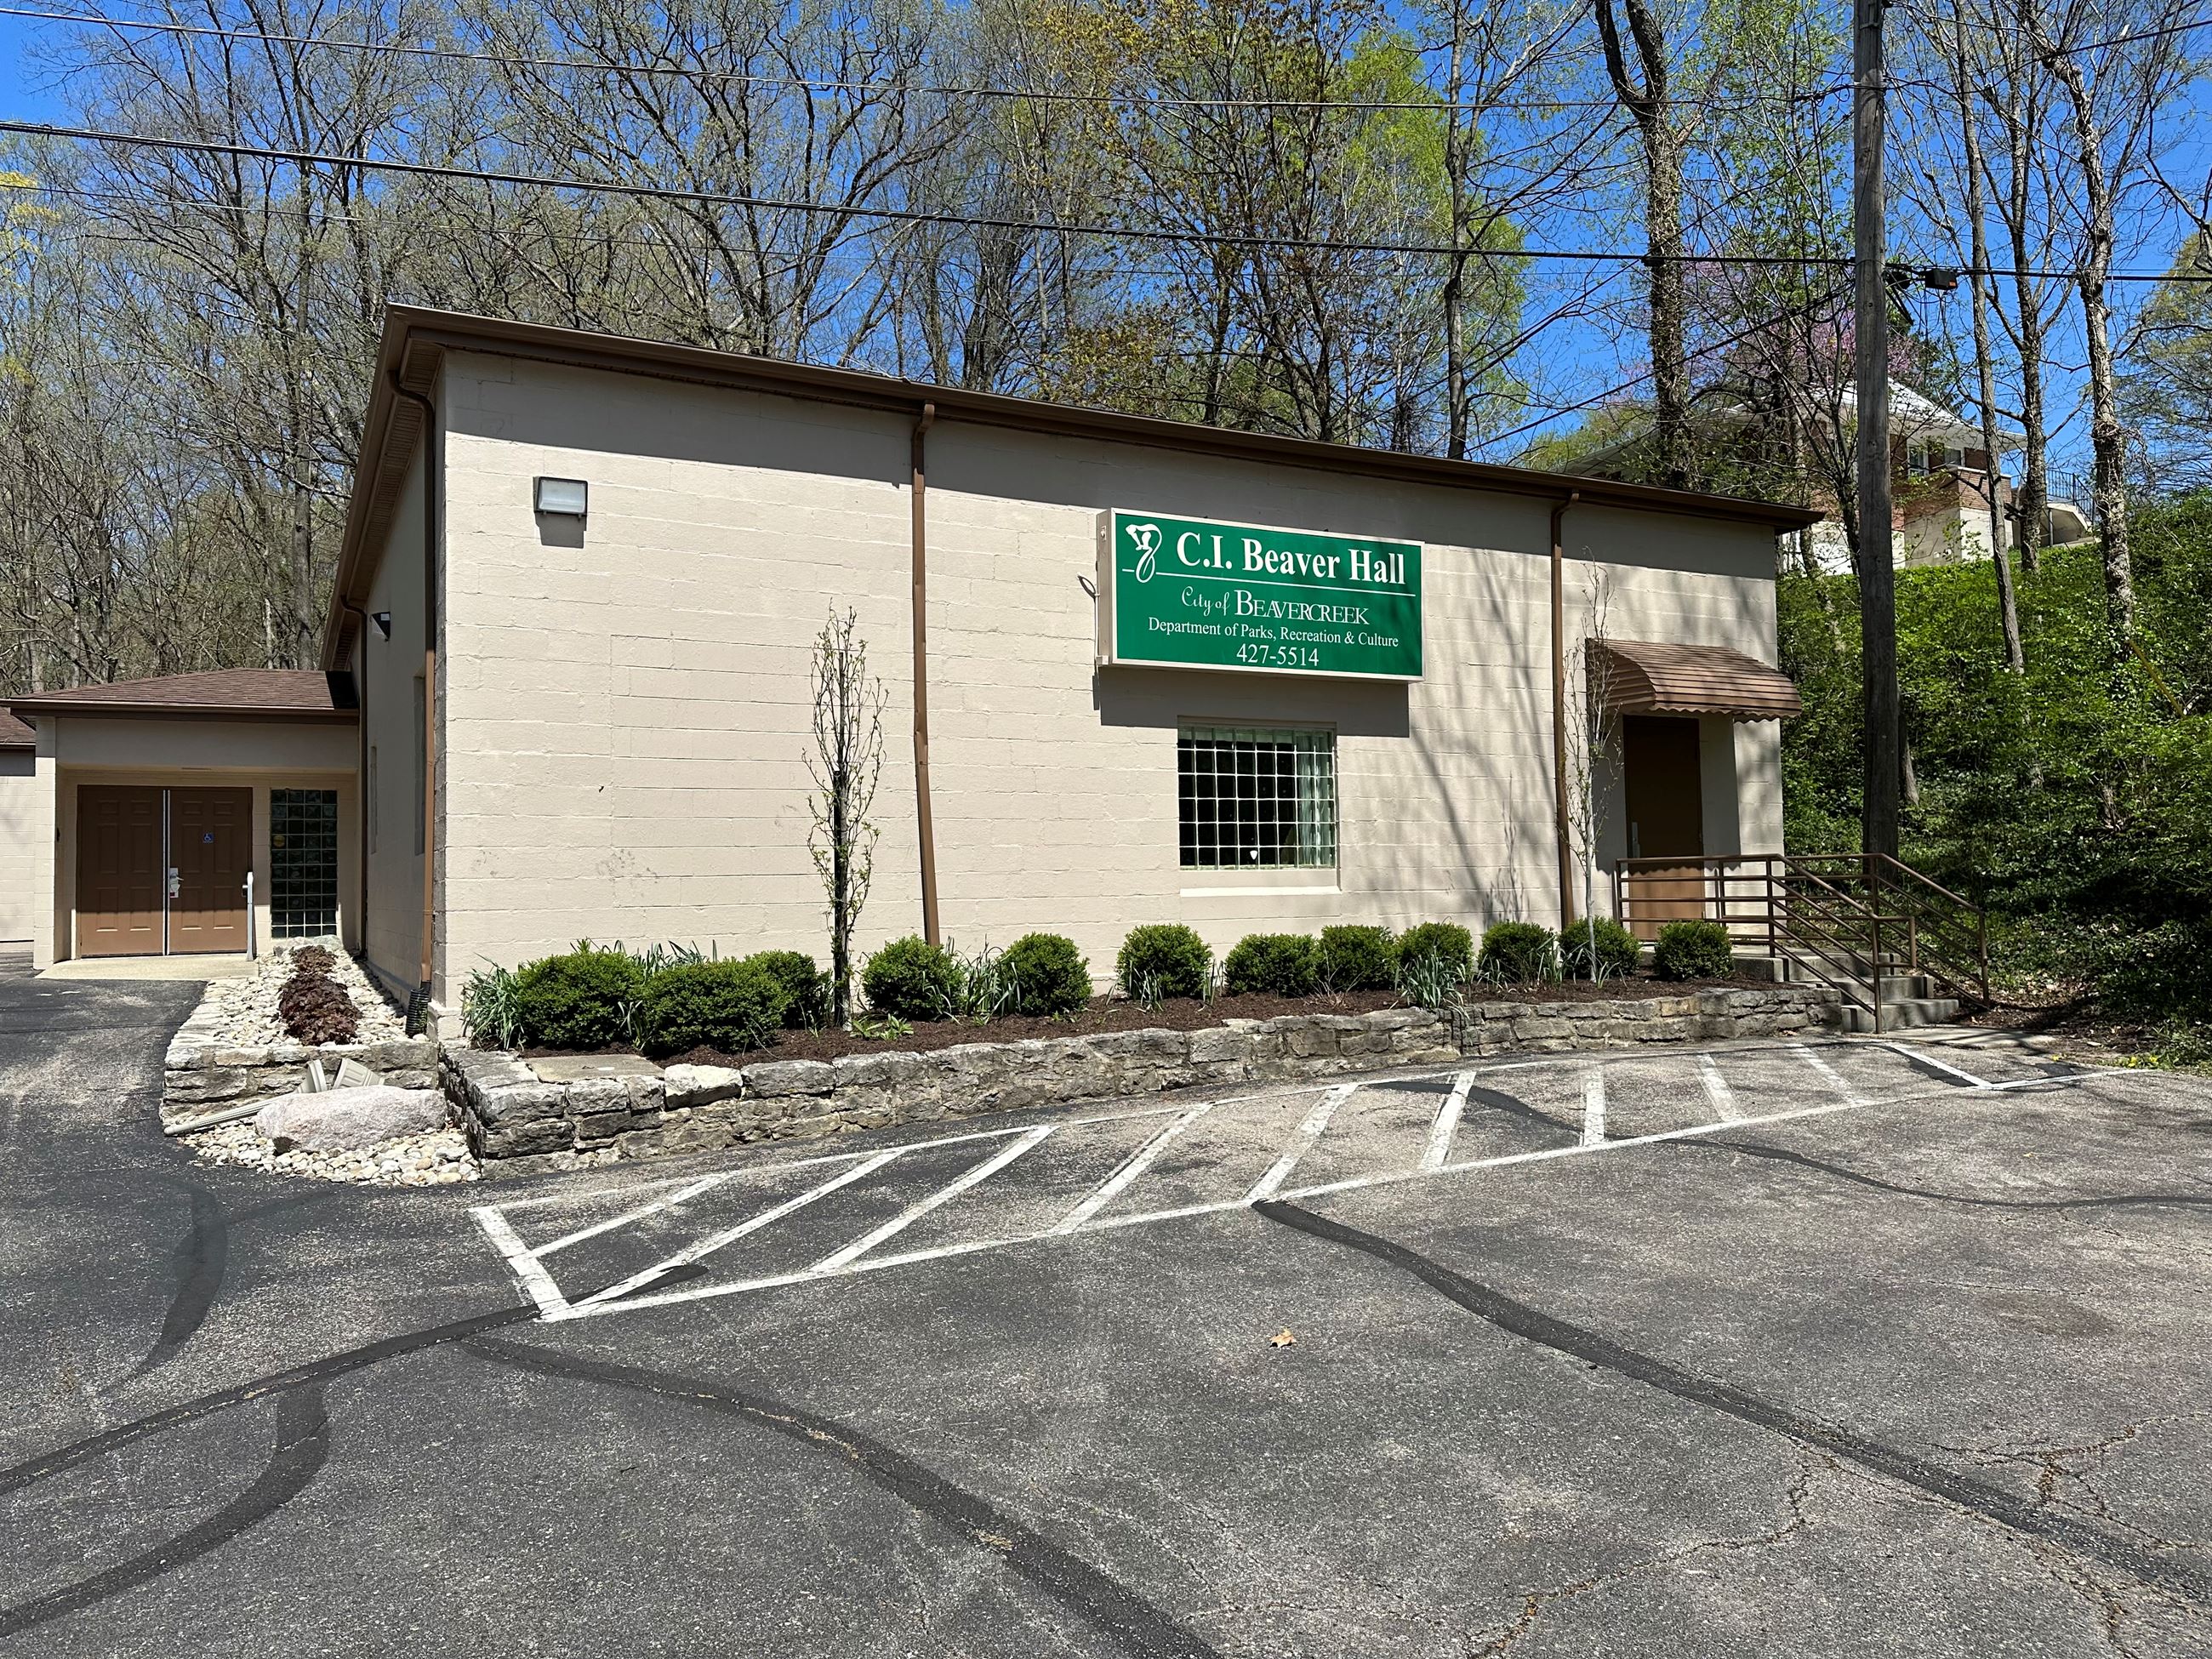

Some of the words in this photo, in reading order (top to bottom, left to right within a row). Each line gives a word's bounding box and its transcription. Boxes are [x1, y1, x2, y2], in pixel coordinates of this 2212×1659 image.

[1177, 533, 1232, 570] C.I.
[1241, 539, 1340, 579] Beaver
[1348, 549, 1406, 584] Hall
[1182, 586, 1211, 616] City
[1215, 592, 1230, 616] of
[1234, 590, 1369, 625] BEAVERCREEK
[1149, 617, 1221, 636] Department
[1225, 624, 1240, 636] of
[1241, 624, 1276, 641] Parks,
[1280, 627, 1340, 643] Recreation
[1344, 631, 1355, 645] &
[1359, 632, 1399, 647] Culture
[1236, 644, 1320, 667] 427-5514
